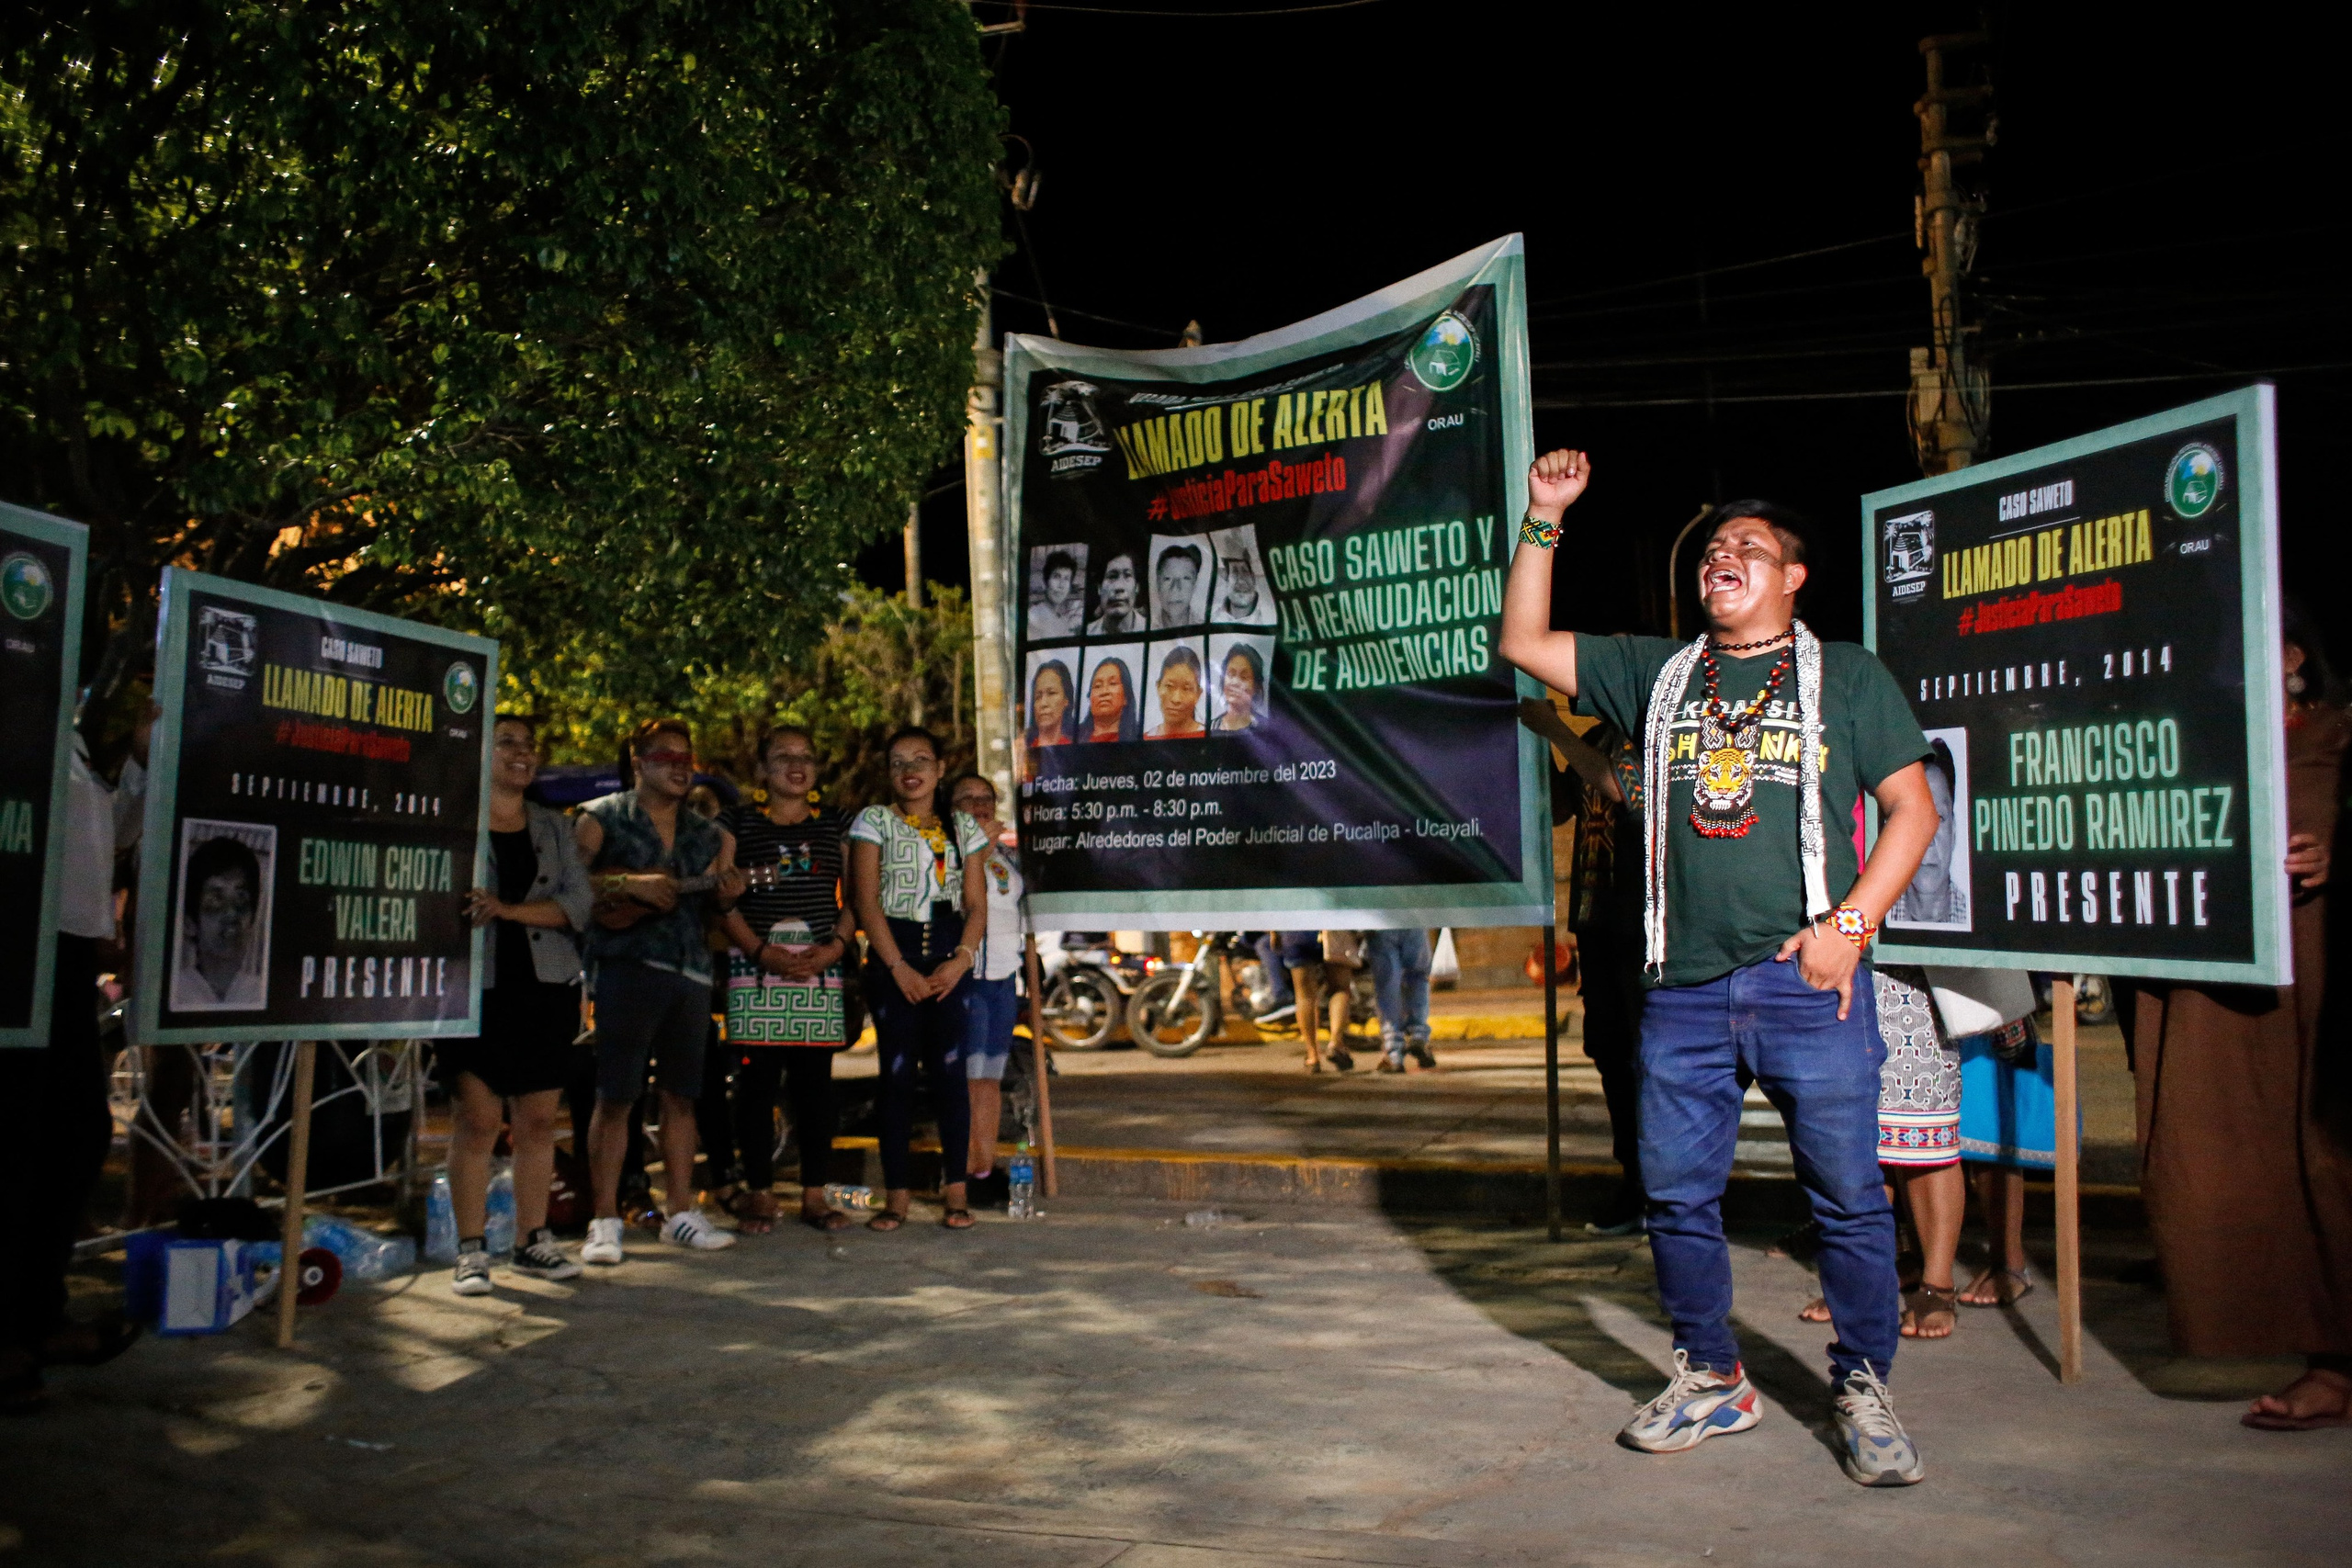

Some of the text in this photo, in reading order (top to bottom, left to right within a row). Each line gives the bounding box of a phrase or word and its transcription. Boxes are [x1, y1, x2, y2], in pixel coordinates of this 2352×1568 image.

[1230, 397, 1266, 458] DE
[1273, 379, 1387, 449] ALERTA
[1428, 413, 1464, 431] ORAU
[1050, 455, 1102, 472] AIDESEP
[1999, 479, 2074, 522] CASO SAWETO
[1268, 514, 1494, 592] CASO SAWETO Y
[1943, 509, 2153, 599] LLAMADO DE ALERTA
[2180, 539, 2210, 554] ORAU
[1279, 565, 1502, 644] LA REANUDACIÓN
[1892, 581, 1926, 597] AIDESEP
[1292, 625, 1489, 690] DE AUDIENCIAS
[1920, 645, 2172, 703] SEPTIEMBRE, 2014
[262, 663, 433, 733] LLAMADO DE ALERTA
[1035, 760, 1337, 794] Fecha: Jueves, 02 de noviembre del 2023
[2009, 717, 2179, 787] FRANCISCO
[395, 792, 441, 817] 2014
[1034, 805, 1067, 821] Hora:
[1071, 802, 1102, 819] 5:30
[1106, 803, 1138, 822] p.m.
[1153, 798, 1187, 817] 8:30
[1190, 799, 1223, 819] p.m.
[1975, 786, 2233, 851] PINEDO RAMIREZ
[1033, 835, 1071, 854] Lugar:
[1076, 829, 1164, 849] Alrededores
[1168, 828, 1191, 846] del
[1195, 827, 1240, 846] Poder
[1245, 825, 1303, 844] Judicial
[1308, 824, 1328, 842] de
[1333, 820, 1400, 842] Pucallpa
[1416, 817, 1484, 841] Ucayali.
[299, 838, 452, 892] EDWIN CHOTA
[335, 894, 417, 942] VALERA
[2005, 871, 2207, 926] PRESENTE
[300, 955, 446, 998] PRESENTE
